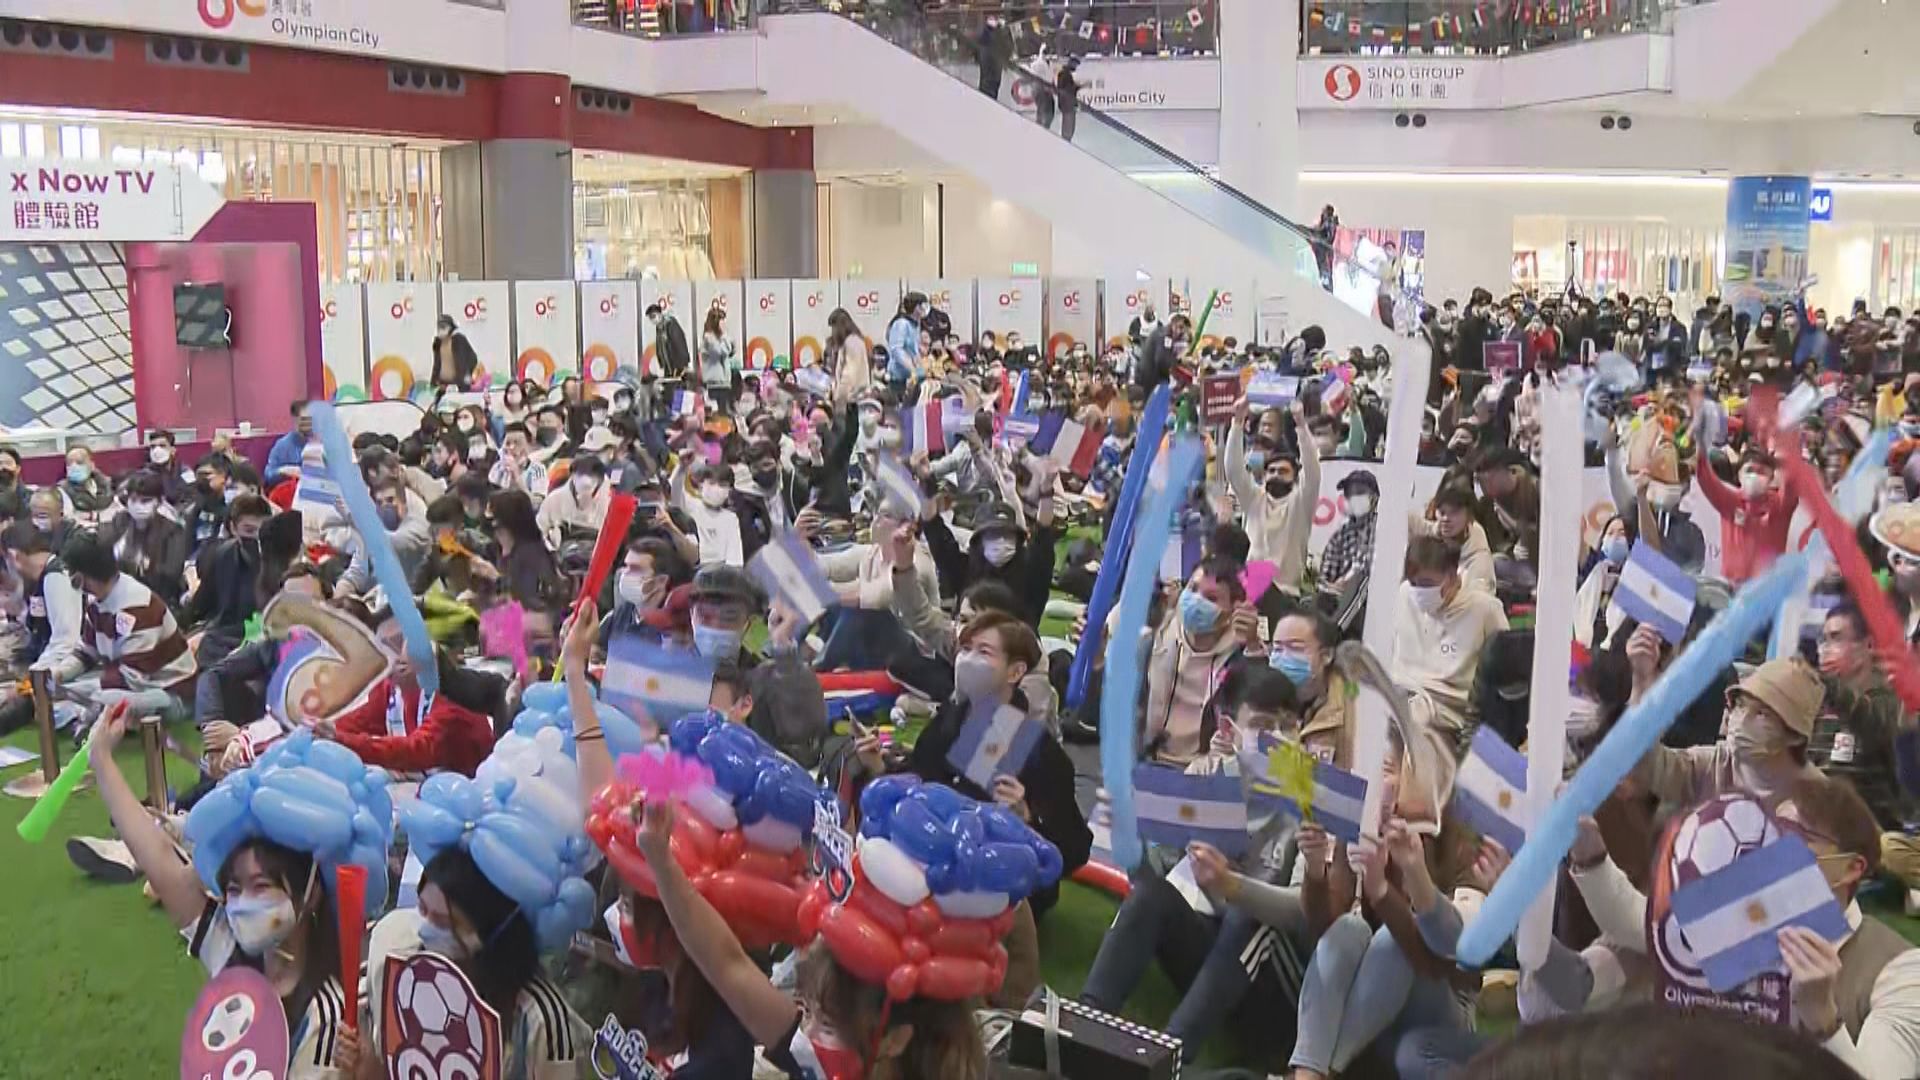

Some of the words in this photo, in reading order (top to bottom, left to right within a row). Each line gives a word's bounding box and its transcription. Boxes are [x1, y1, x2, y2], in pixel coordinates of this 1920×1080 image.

[272, 18, 347, 42] Olympian
[350, 28, 379, 48] City
[1367, 67, 1405, 79] SINO
[1409, 67, 1464, 79] GROUP
[1080, 93, 1135, 105] lympian
[1138, 90, 1165, 103] City
[38, 168, 109, 193] Now
[115, 170, 155, 193] TV
[15, 201, 99, 229] 體驗館
[535, 296, 556, 315] OC
[600, 294, 619, 313] OC
[760, 293, 775, 309] OC
[857, 291, 878, 308] OC
[999, 290, 1021, 305] OC
[1063, 290, 1080, 307] OC
[391, 297, 413, 319] OC
[464, 297, 487, 318] OC
